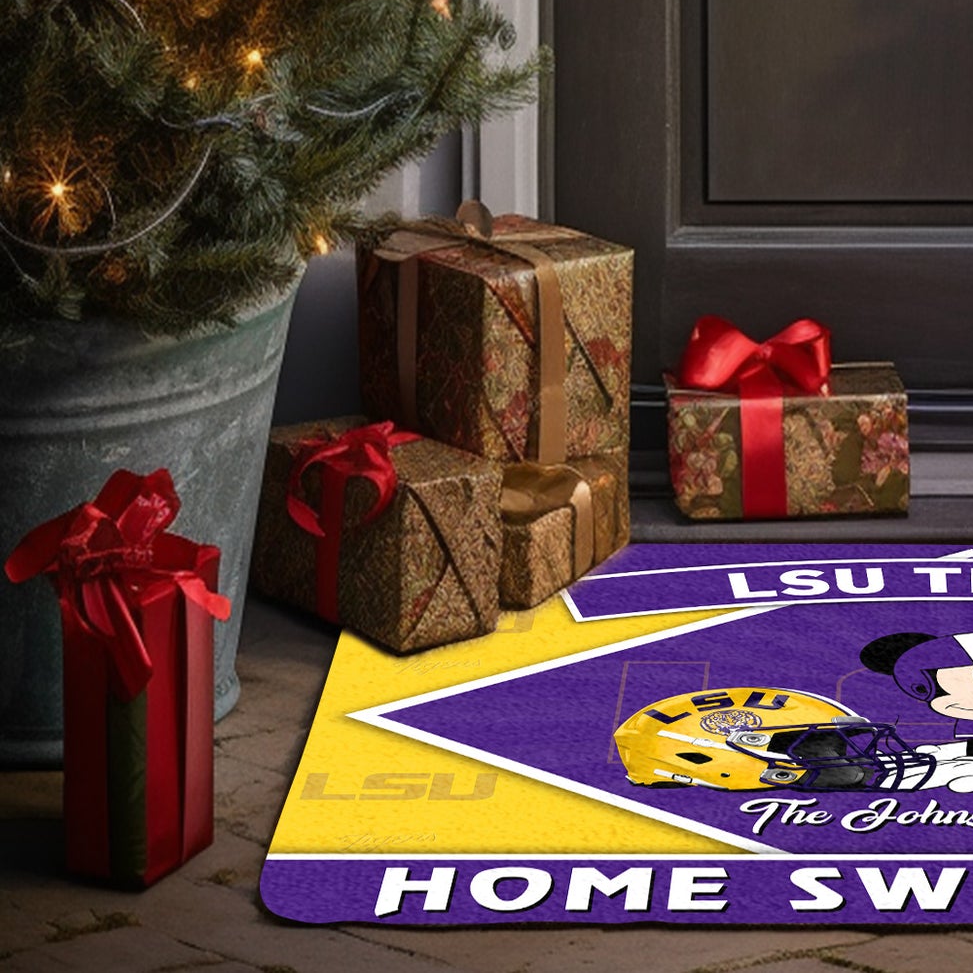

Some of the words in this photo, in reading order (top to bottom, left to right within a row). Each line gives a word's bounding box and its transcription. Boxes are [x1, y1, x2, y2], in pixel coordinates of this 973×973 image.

[727, 567, 885, 599] LSU
[644, 691, 790, 725] LSU
[300, 772, 499, 801] LSU
[739, 797, 834, 835] The
[374, 866, 731, 918] HOME
